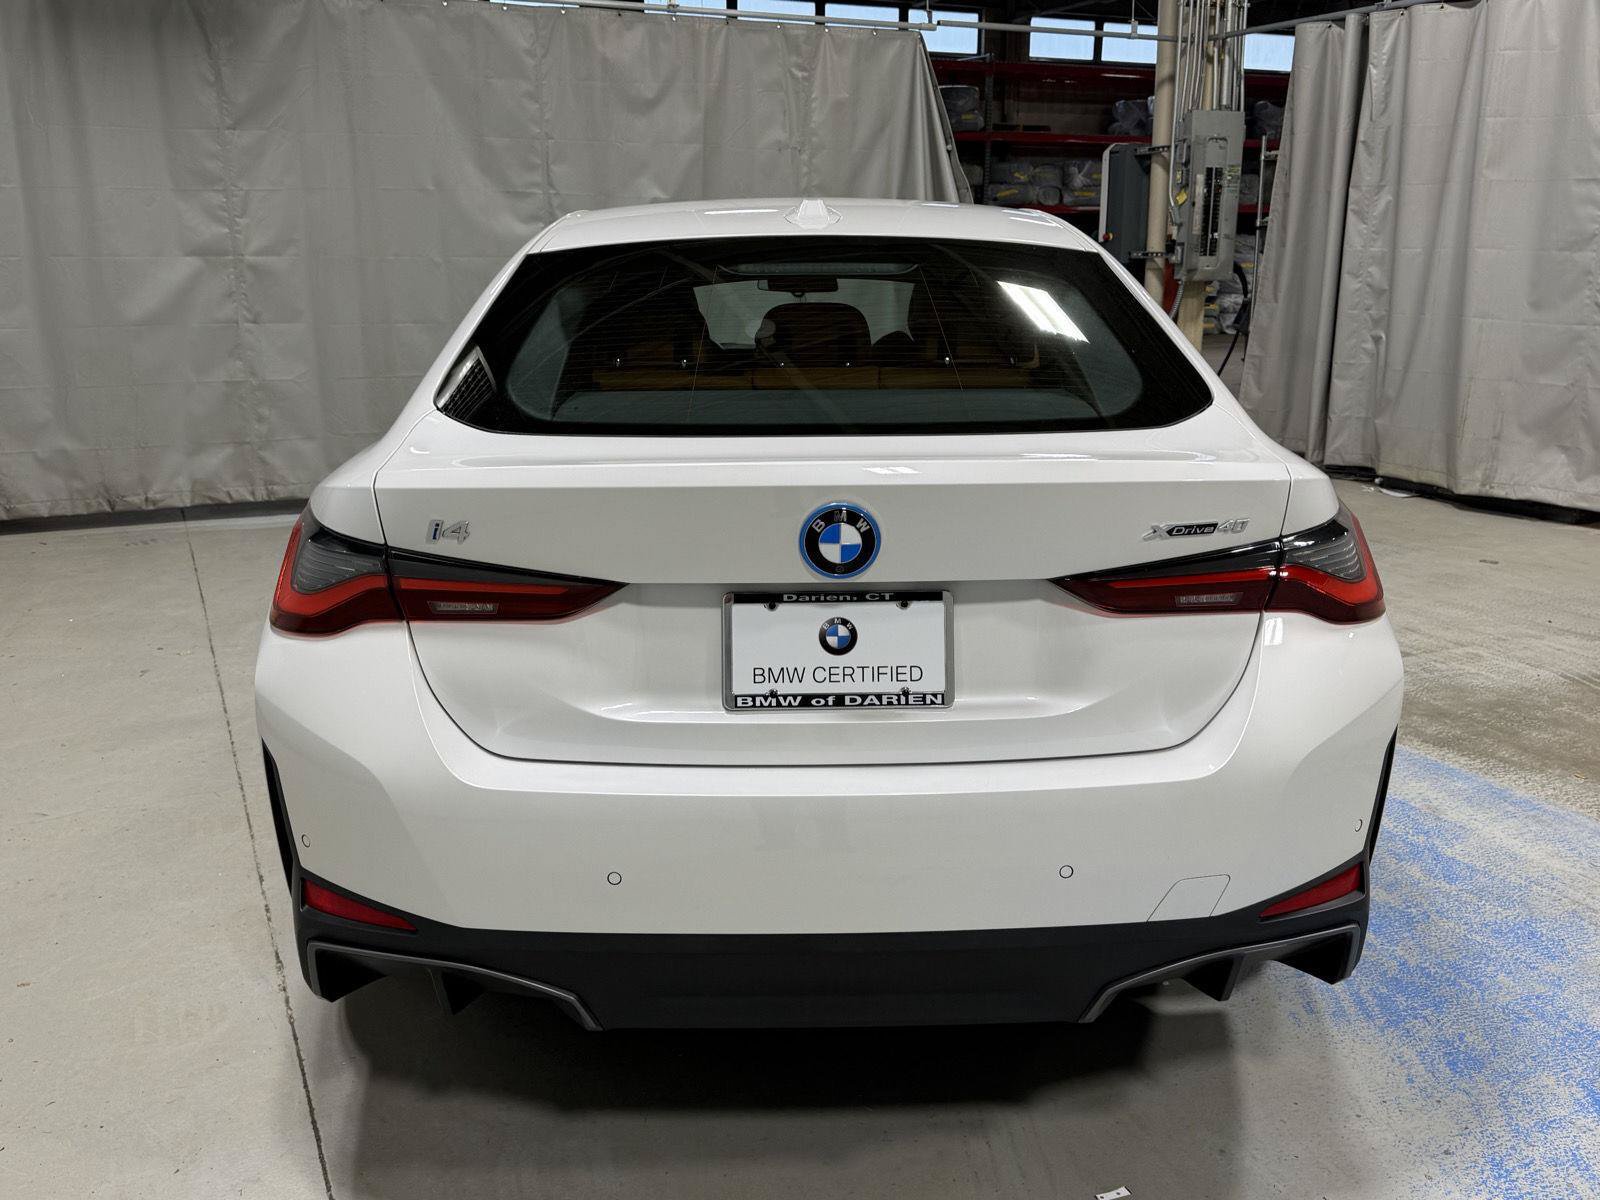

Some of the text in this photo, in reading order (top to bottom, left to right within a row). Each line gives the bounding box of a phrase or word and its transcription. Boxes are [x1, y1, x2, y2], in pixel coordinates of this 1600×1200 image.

[811, 510, 871, 533] BMW
[865, 592, 895, 601] CT
[822, 617, 854, 631] BMW
[753, 665, 923, 684] BMW CERTIFIED
[736, 694, 943, 707] BMW of DARIEN
